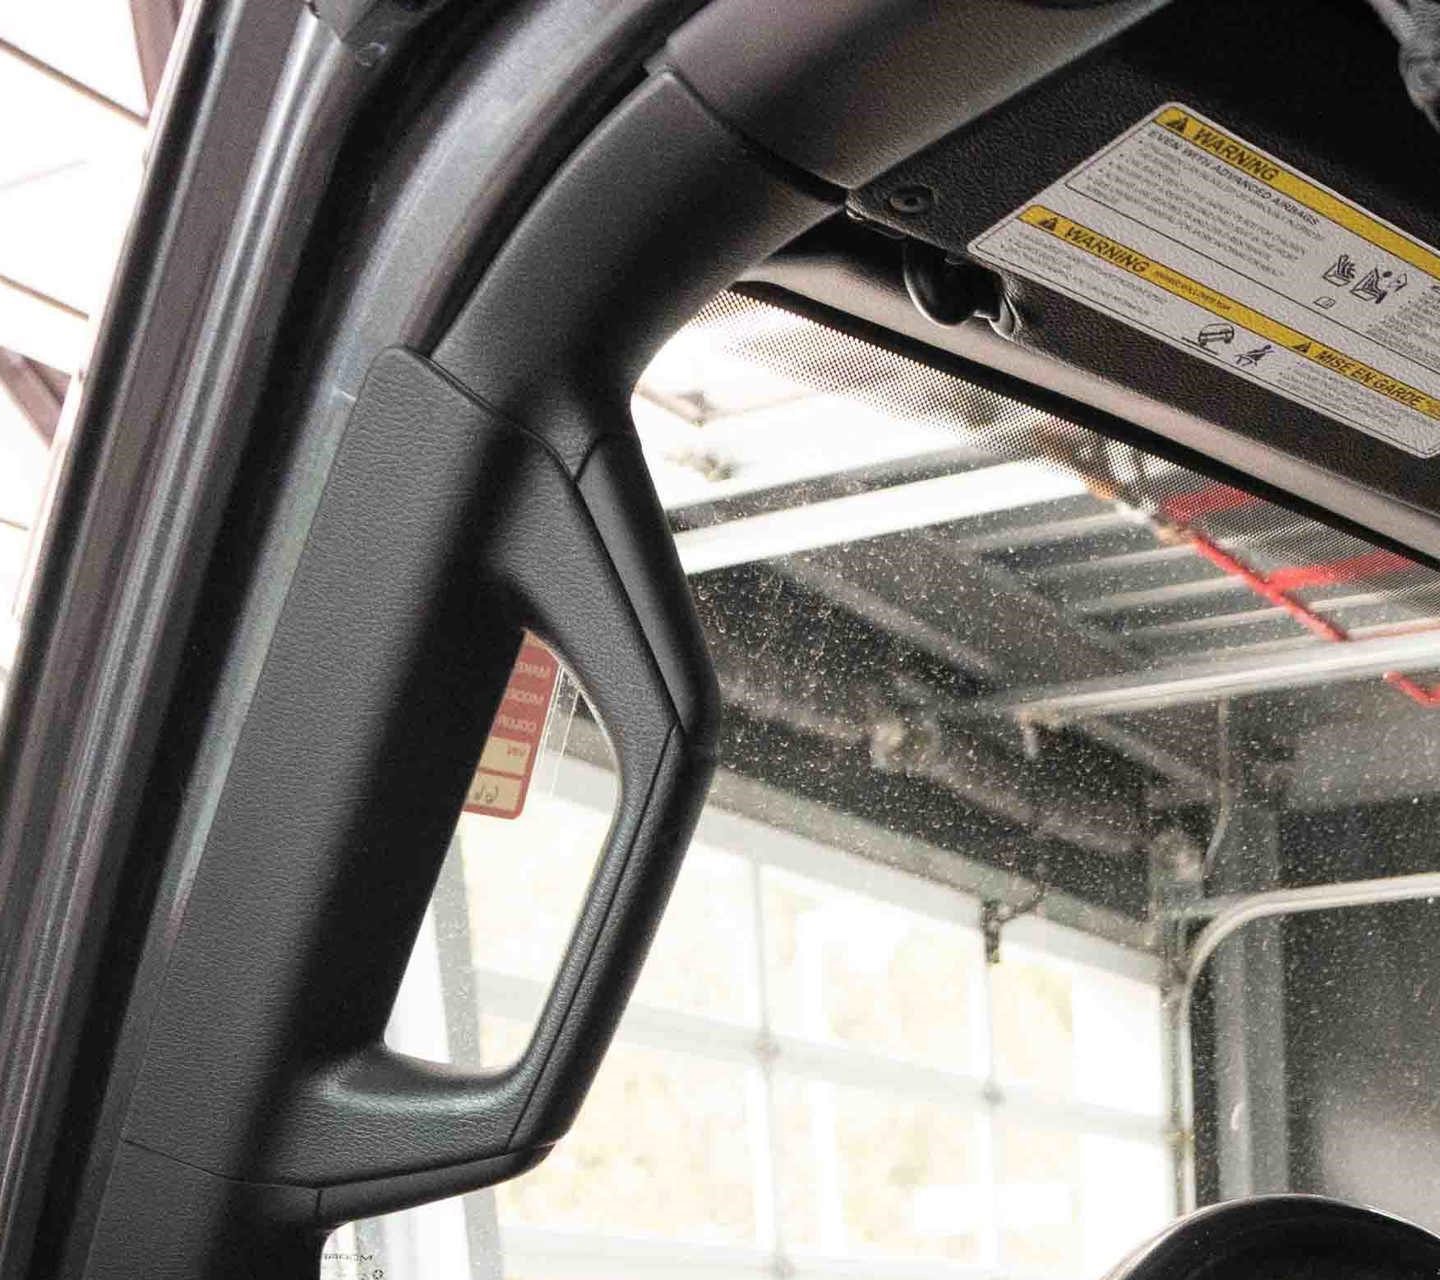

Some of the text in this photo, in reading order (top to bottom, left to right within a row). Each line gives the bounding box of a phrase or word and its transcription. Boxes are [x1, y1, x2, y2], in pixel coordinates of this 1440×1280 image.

[1191, 127, 1280, 181] WARNING
[1064, 226, 1150, 274] WARNING
[1314, 350, 1427, 406] MISE EN GARDE
